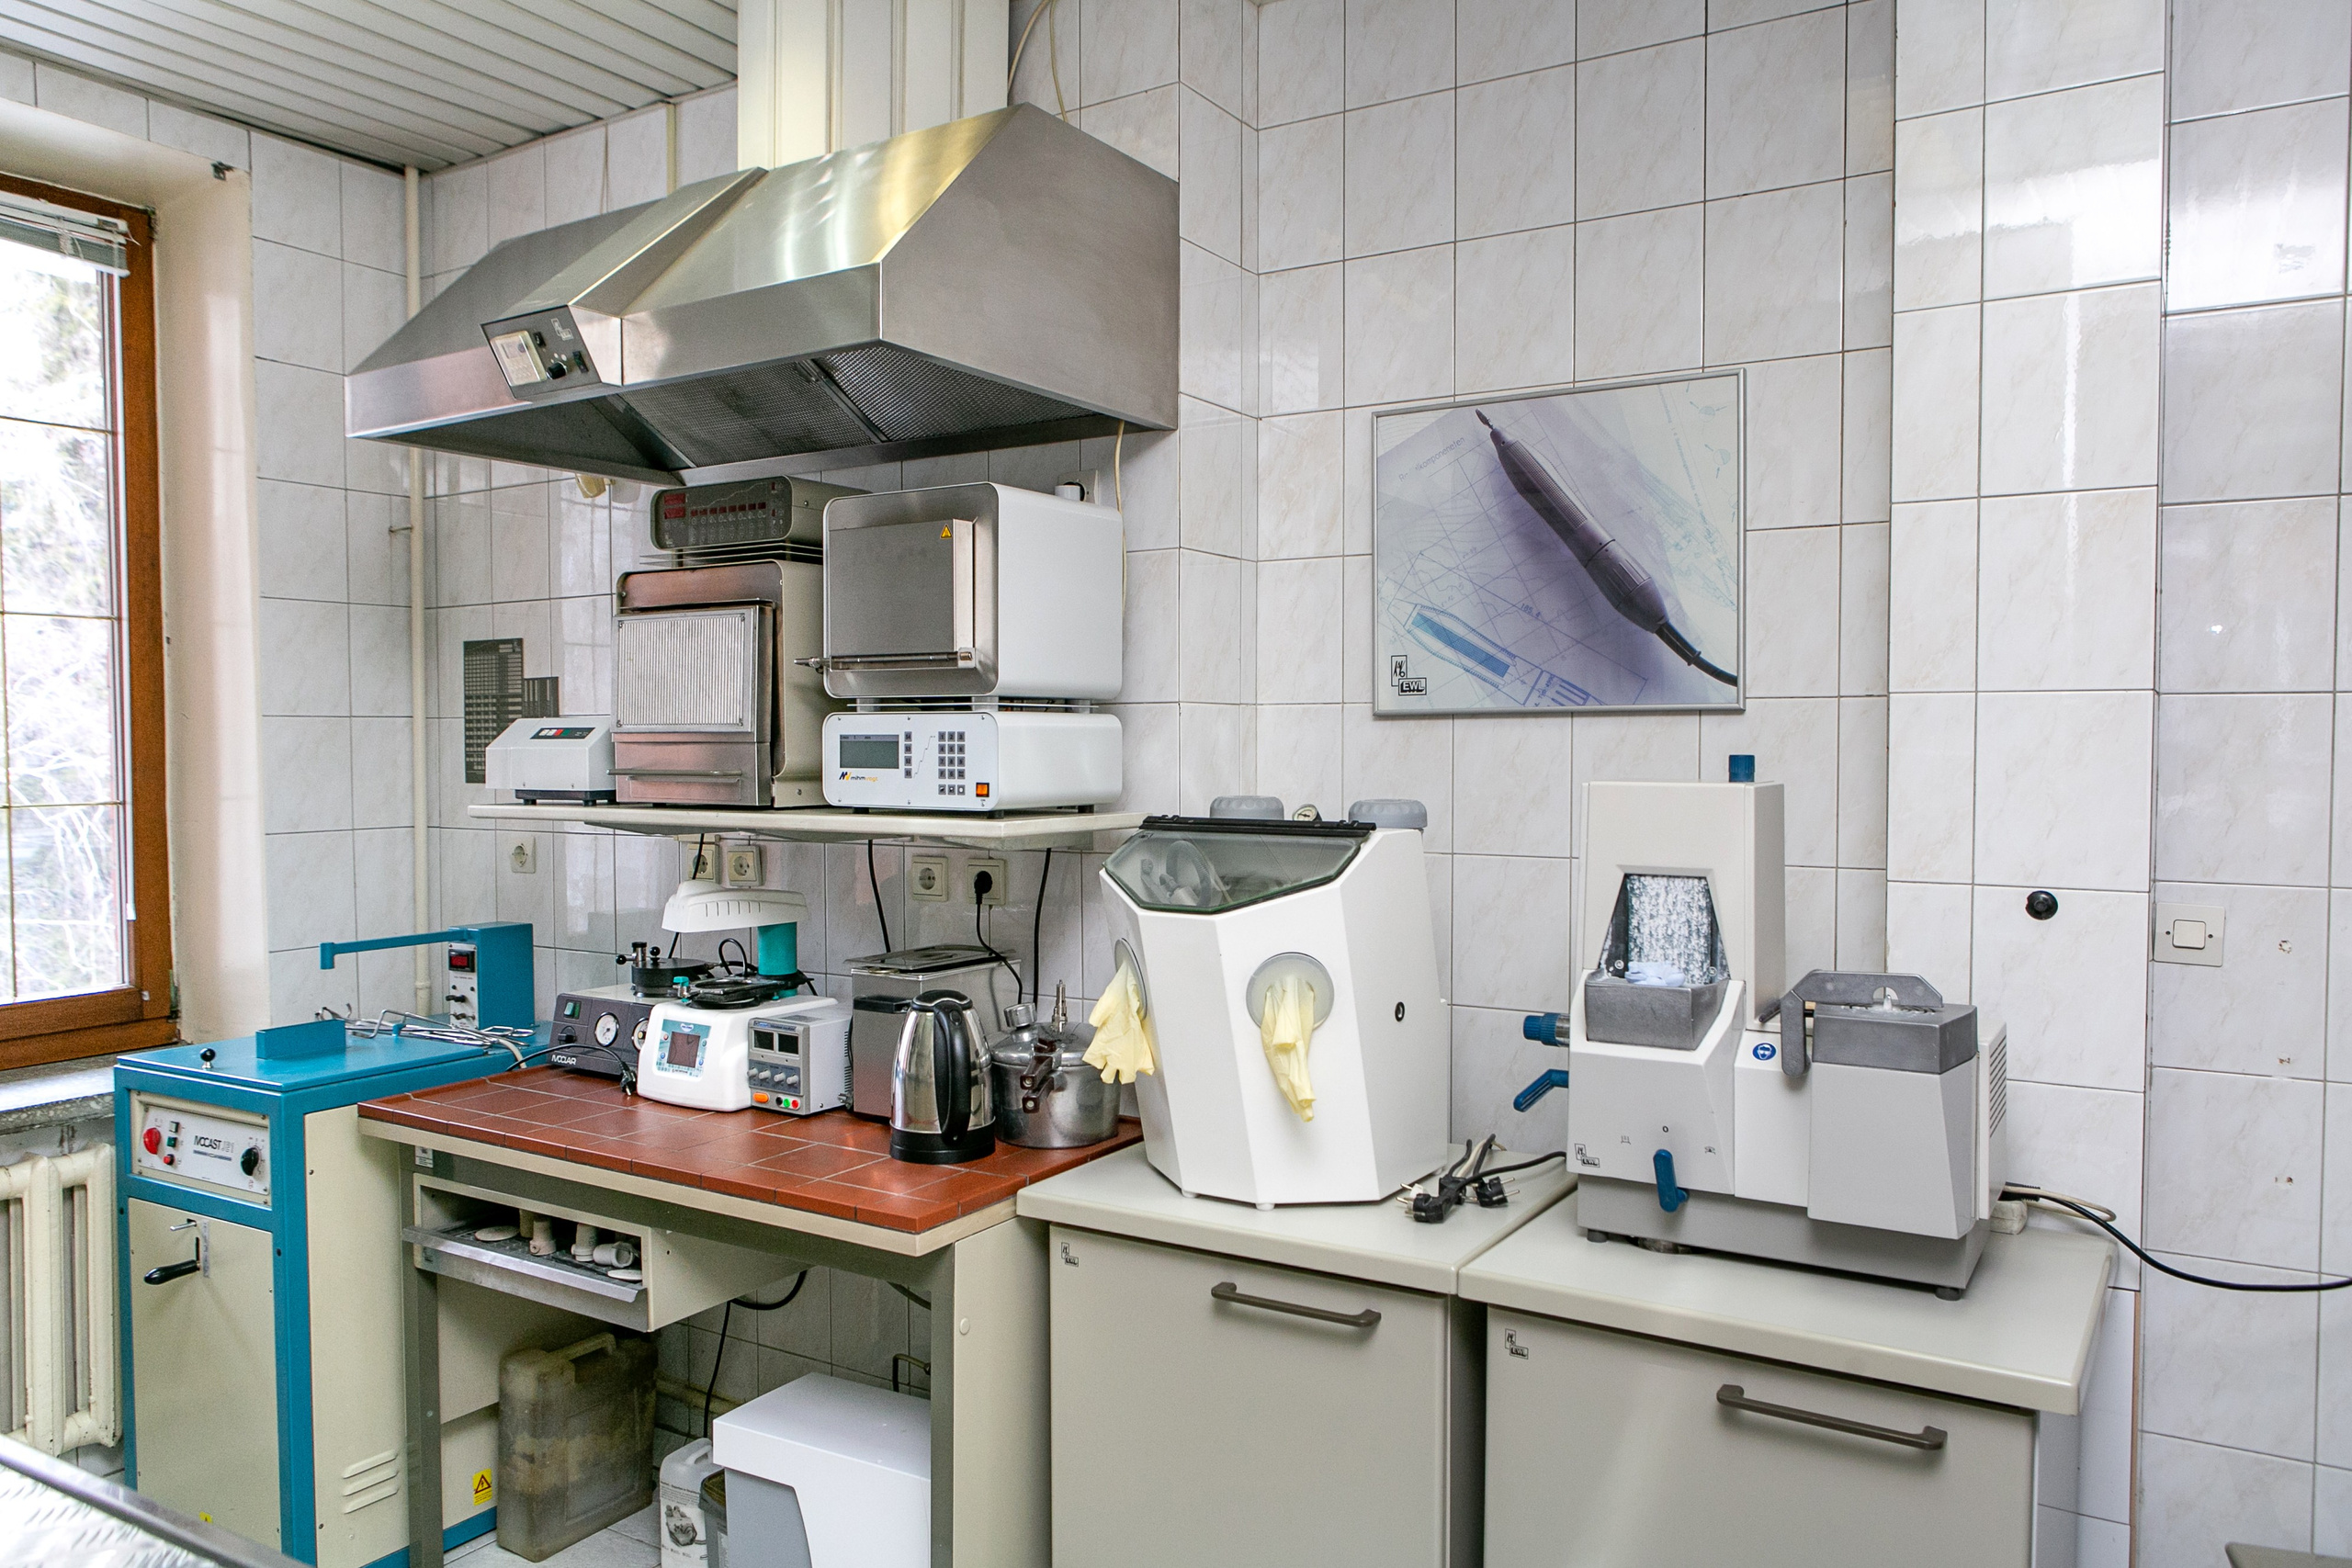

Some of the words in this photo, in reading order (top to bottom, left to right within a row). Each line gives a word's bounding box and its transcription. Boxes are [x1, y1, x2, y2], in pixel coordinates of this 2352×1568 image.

[1401, 680, 1425, 693] EWL
[551, 1054, 576, 1066] IVOCLAR
[194, 1135, 222, 1150] IVOCAST
